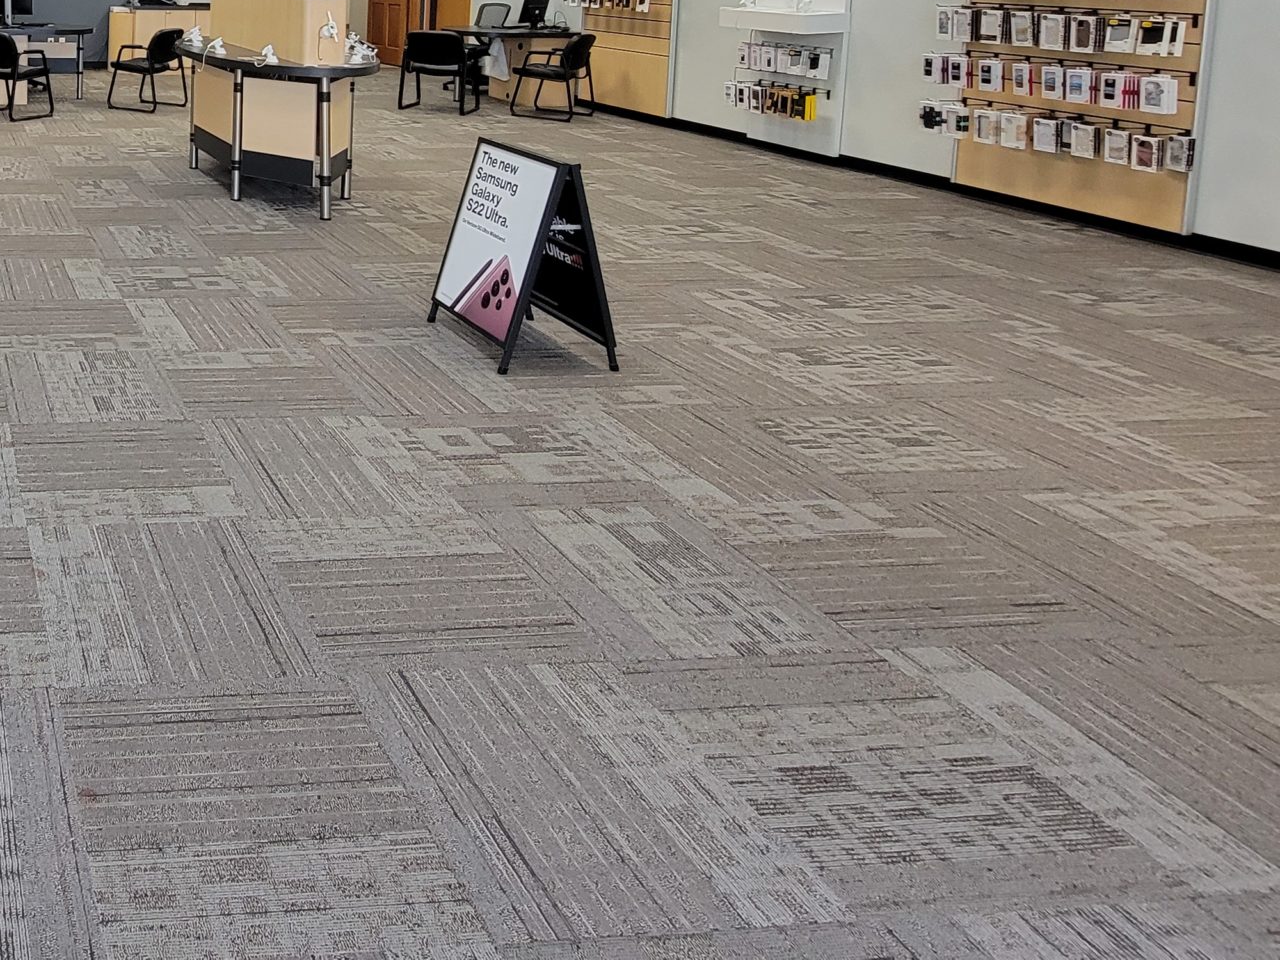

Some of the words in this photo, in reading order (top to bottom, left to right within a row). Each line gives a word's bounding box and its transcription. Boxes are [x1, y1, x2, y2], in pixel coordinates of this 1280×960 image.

[481, 150, 498, 168] The
[498, 160, 520, 175] new
[471, 182, 503, 208] Galaxy
[475, 166, 519, 197] Samsung
[466, 198, 485, 217] S22
[484, 206, 509, 228] Ultra.
